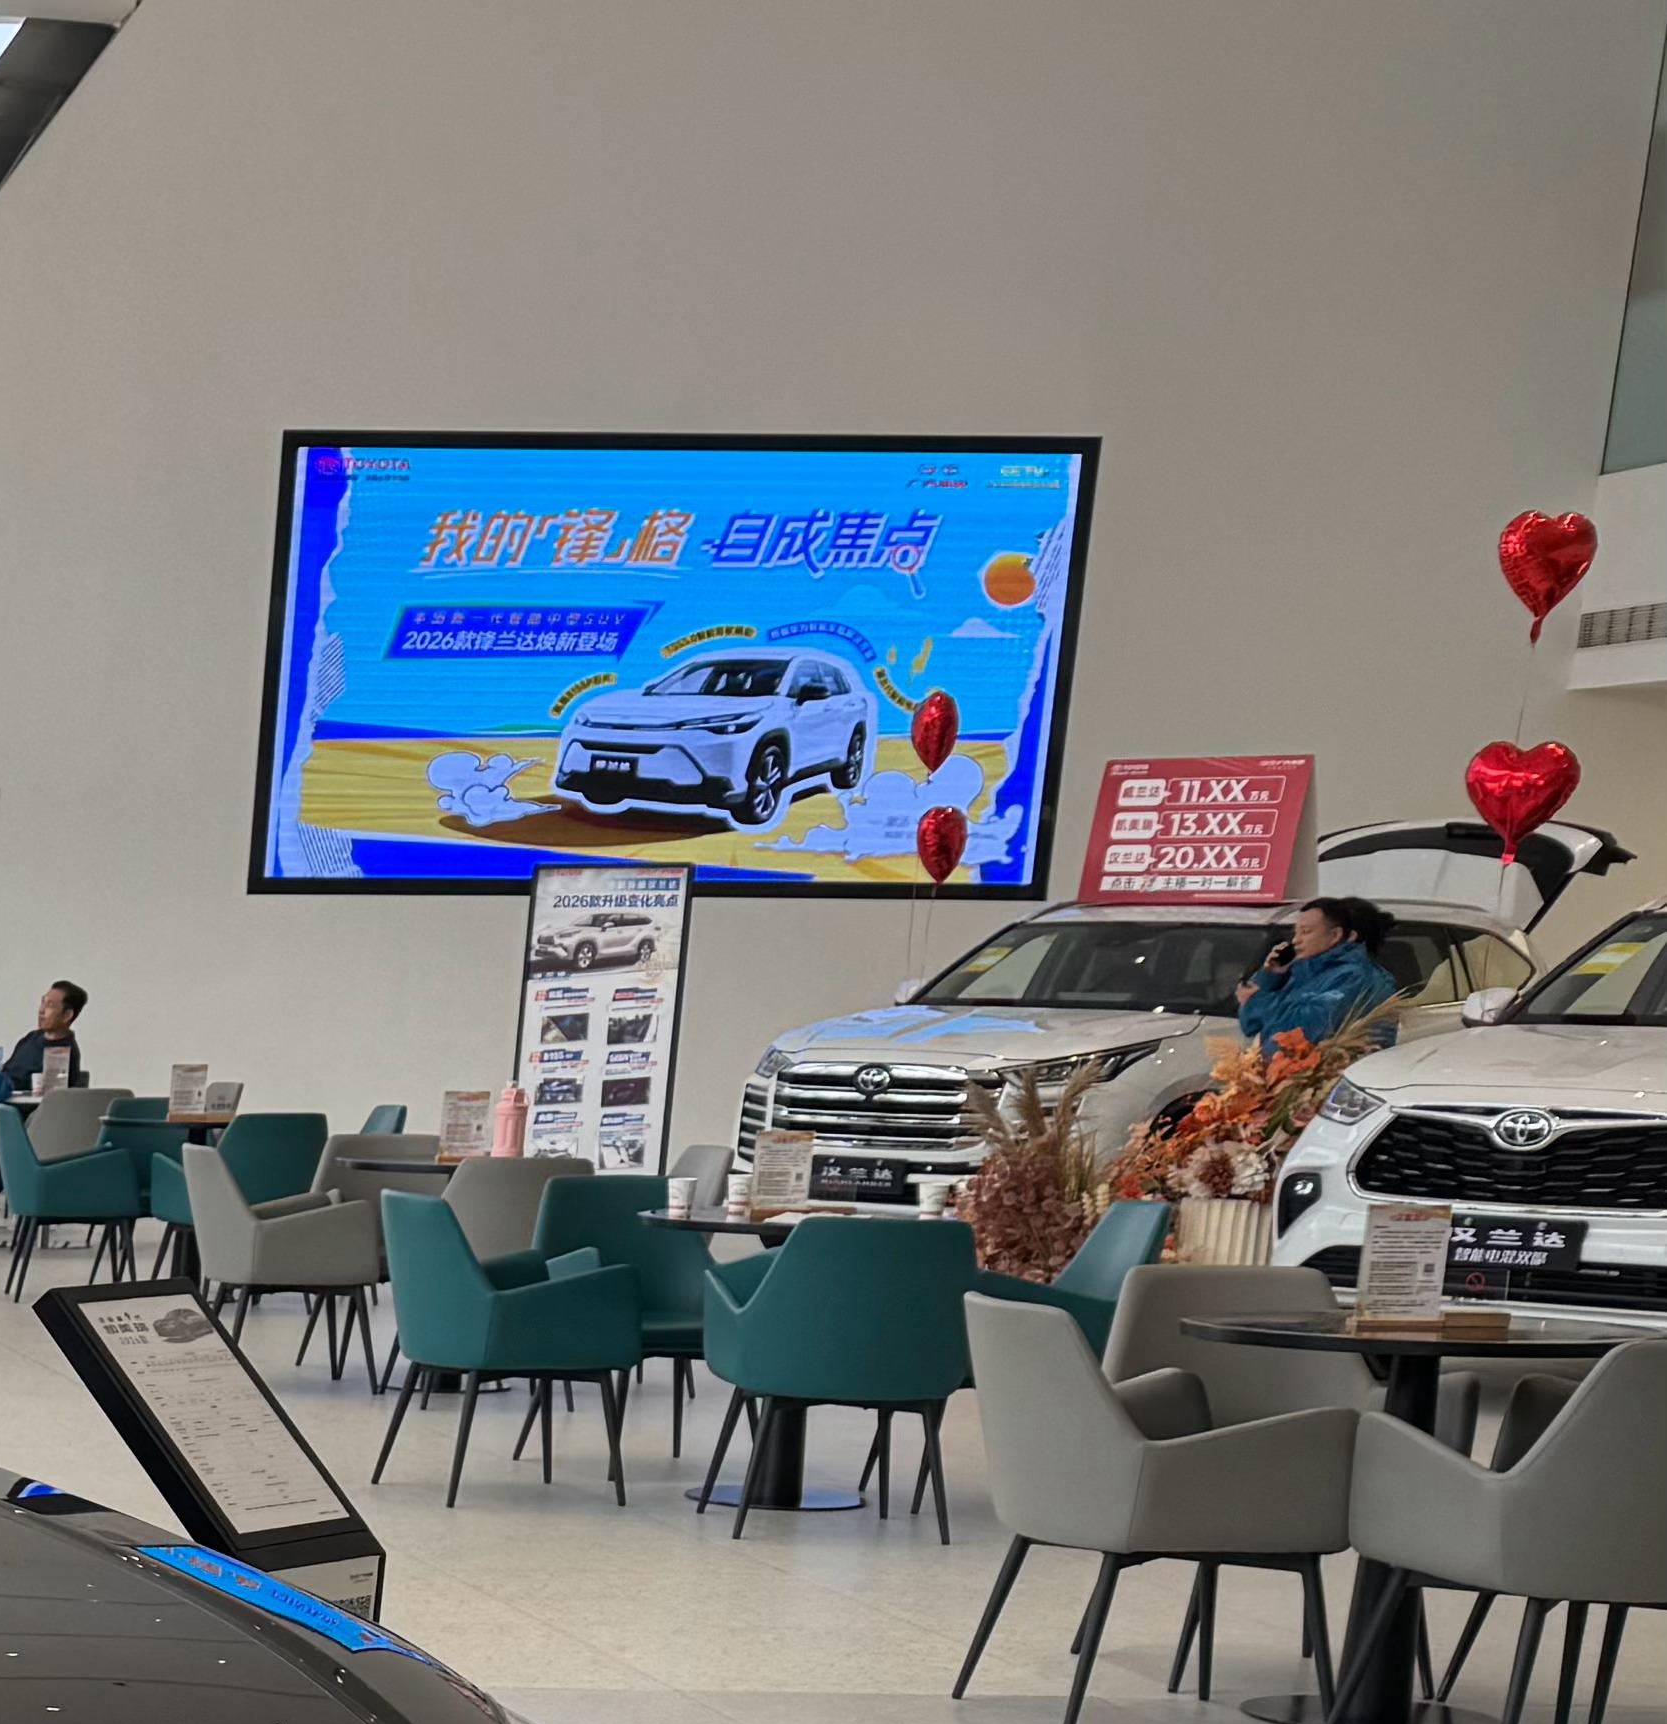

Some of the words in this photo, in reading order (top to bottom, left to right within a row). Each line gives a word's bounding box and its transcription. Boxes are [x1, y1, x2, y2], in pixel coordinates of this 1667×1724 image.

[709, 509, 943, 578] 自成焦点
[401, 630, 619, 653] 2026款锋兰达焕新登场
[1179, 779, 1250, 803] 11.XX
[1170, 812, 1246, 836] 13.XX
[1157, 846, 1243, 869] 20.XX
[821, 1166, 893, 1180] 汉兰达
